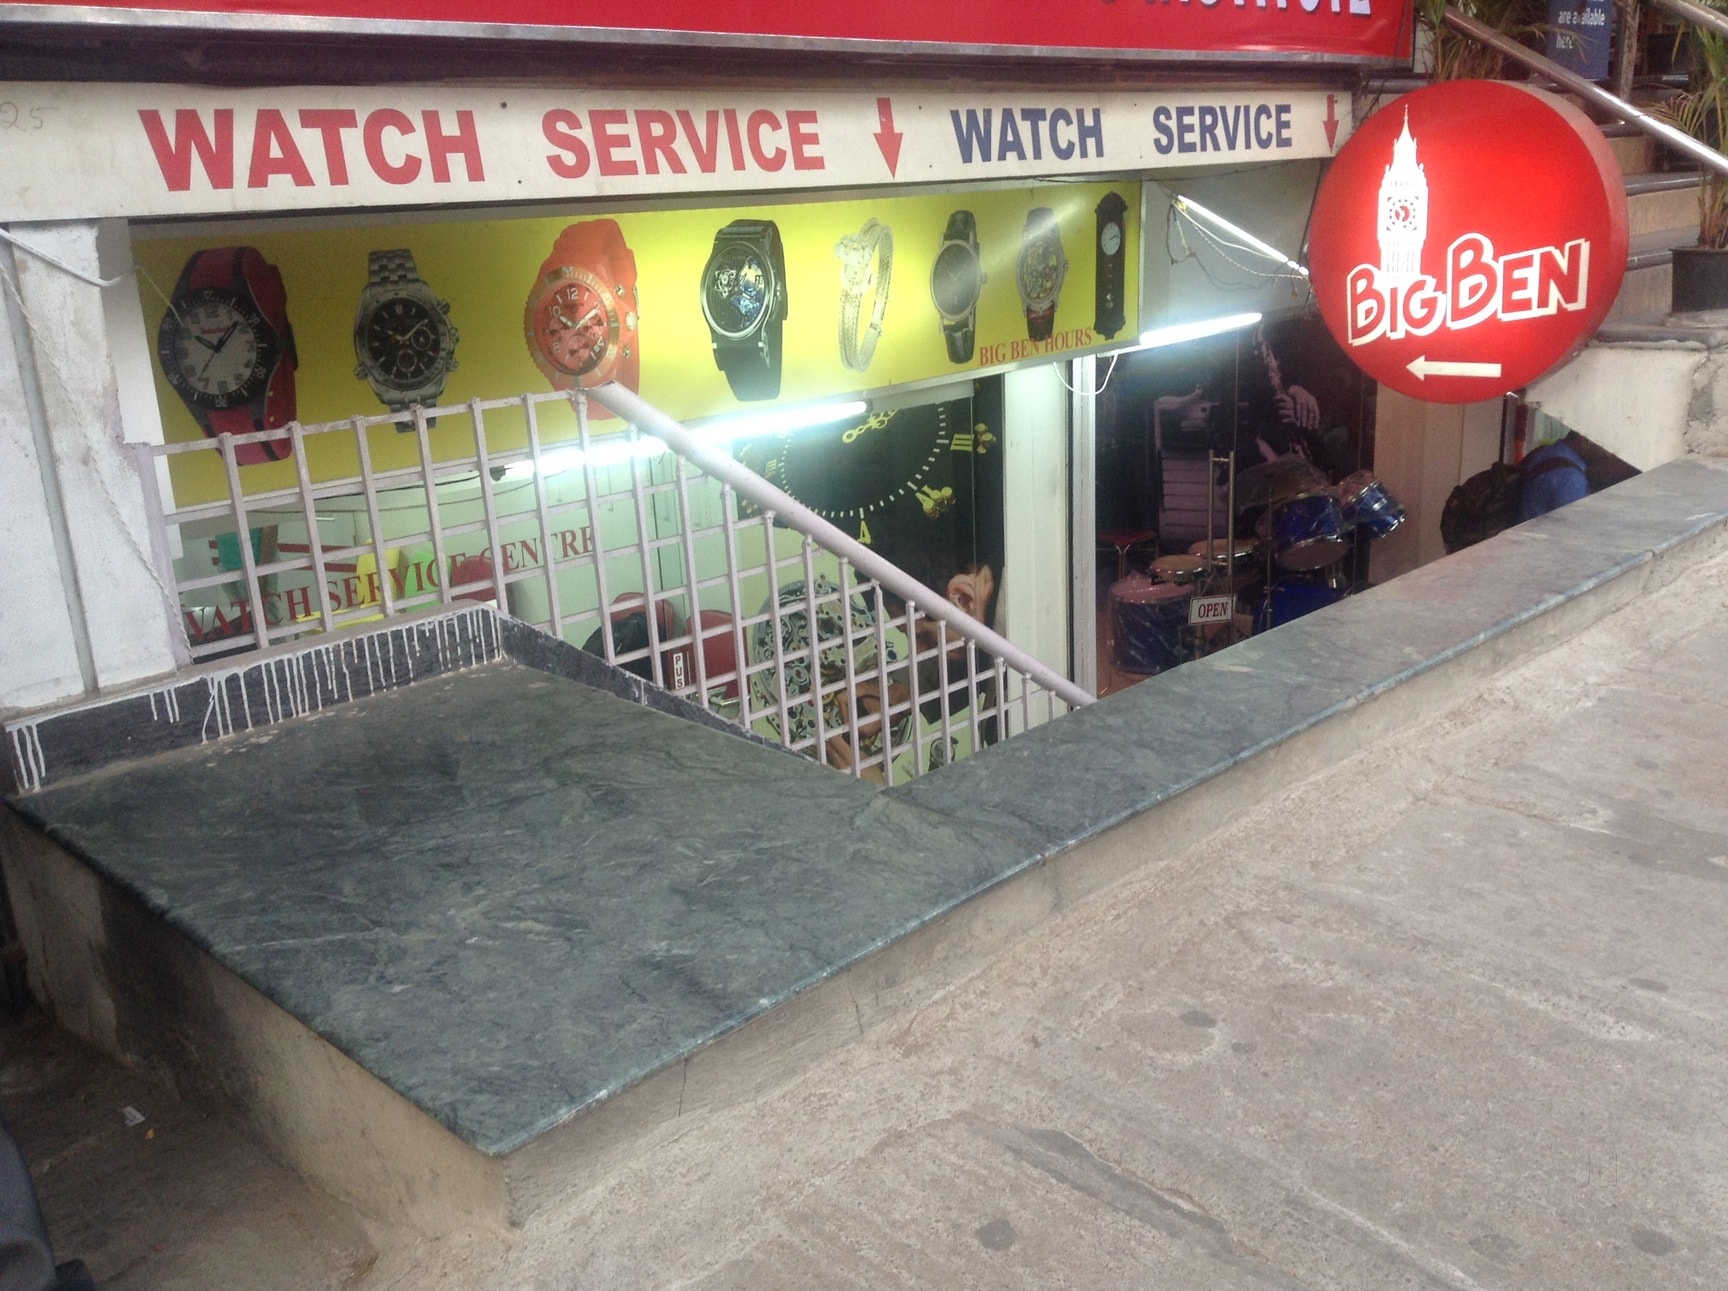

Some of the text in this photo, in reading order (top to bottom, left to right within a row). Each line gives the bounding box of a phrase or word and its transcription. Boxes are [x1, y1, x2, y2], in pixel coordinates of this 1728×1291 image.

[1572, 8, 1605, 26] aailable
[139, 107, 825, 191] WATCH SERVICE
[950, 104, 1293, 164] WATCH SERVICE
[1346, 232, 1590, 346] BIG BEN
[979, 328, 1092, 366] BIG BEN HOURS
[478, 526, 593, 577] CENRE
[1198, 602, 1229, 619] OPEN
[674, 655, 683, 688] PUS
